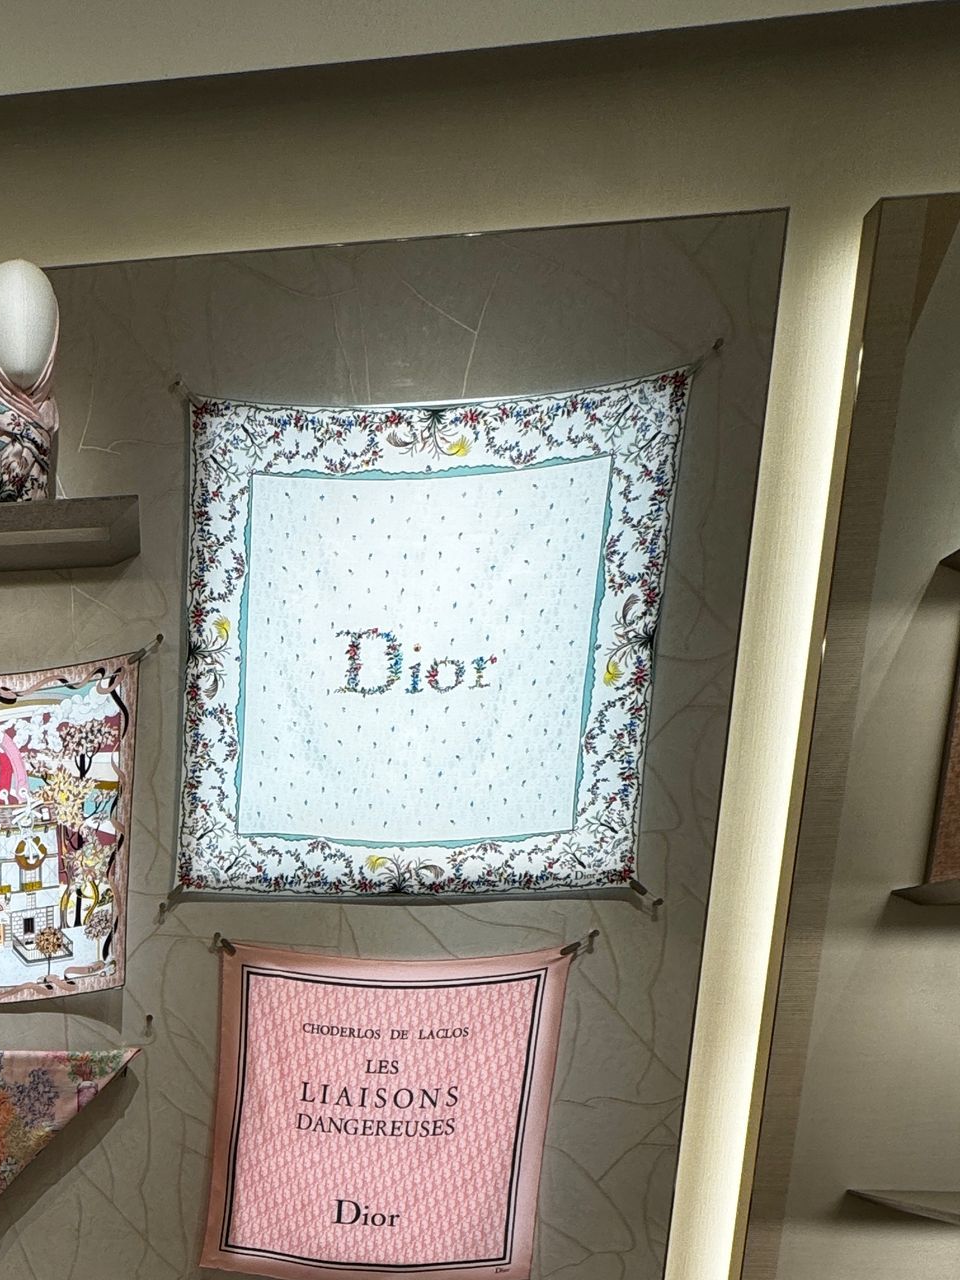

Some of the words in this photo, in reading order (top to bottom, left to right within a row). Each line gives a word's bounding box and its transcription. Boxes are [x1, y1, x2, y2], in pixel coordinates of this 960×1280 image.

[334, 627, 498, 696] Dior
[574, 870, 597, 880] Dior
[302, 1022, 381, 1040] CHODERLOS
[390, 1029, 409, 1040] DE
[418, 1026, 470, 1040] LACLOS
[365, 1059, 399, 1075] LES
[300, 1081, 459, 1110] LIAISONS
[296, 1112, 456, 1138] DANGEREUSES
[331, 1199, 401, 1228] Dior
